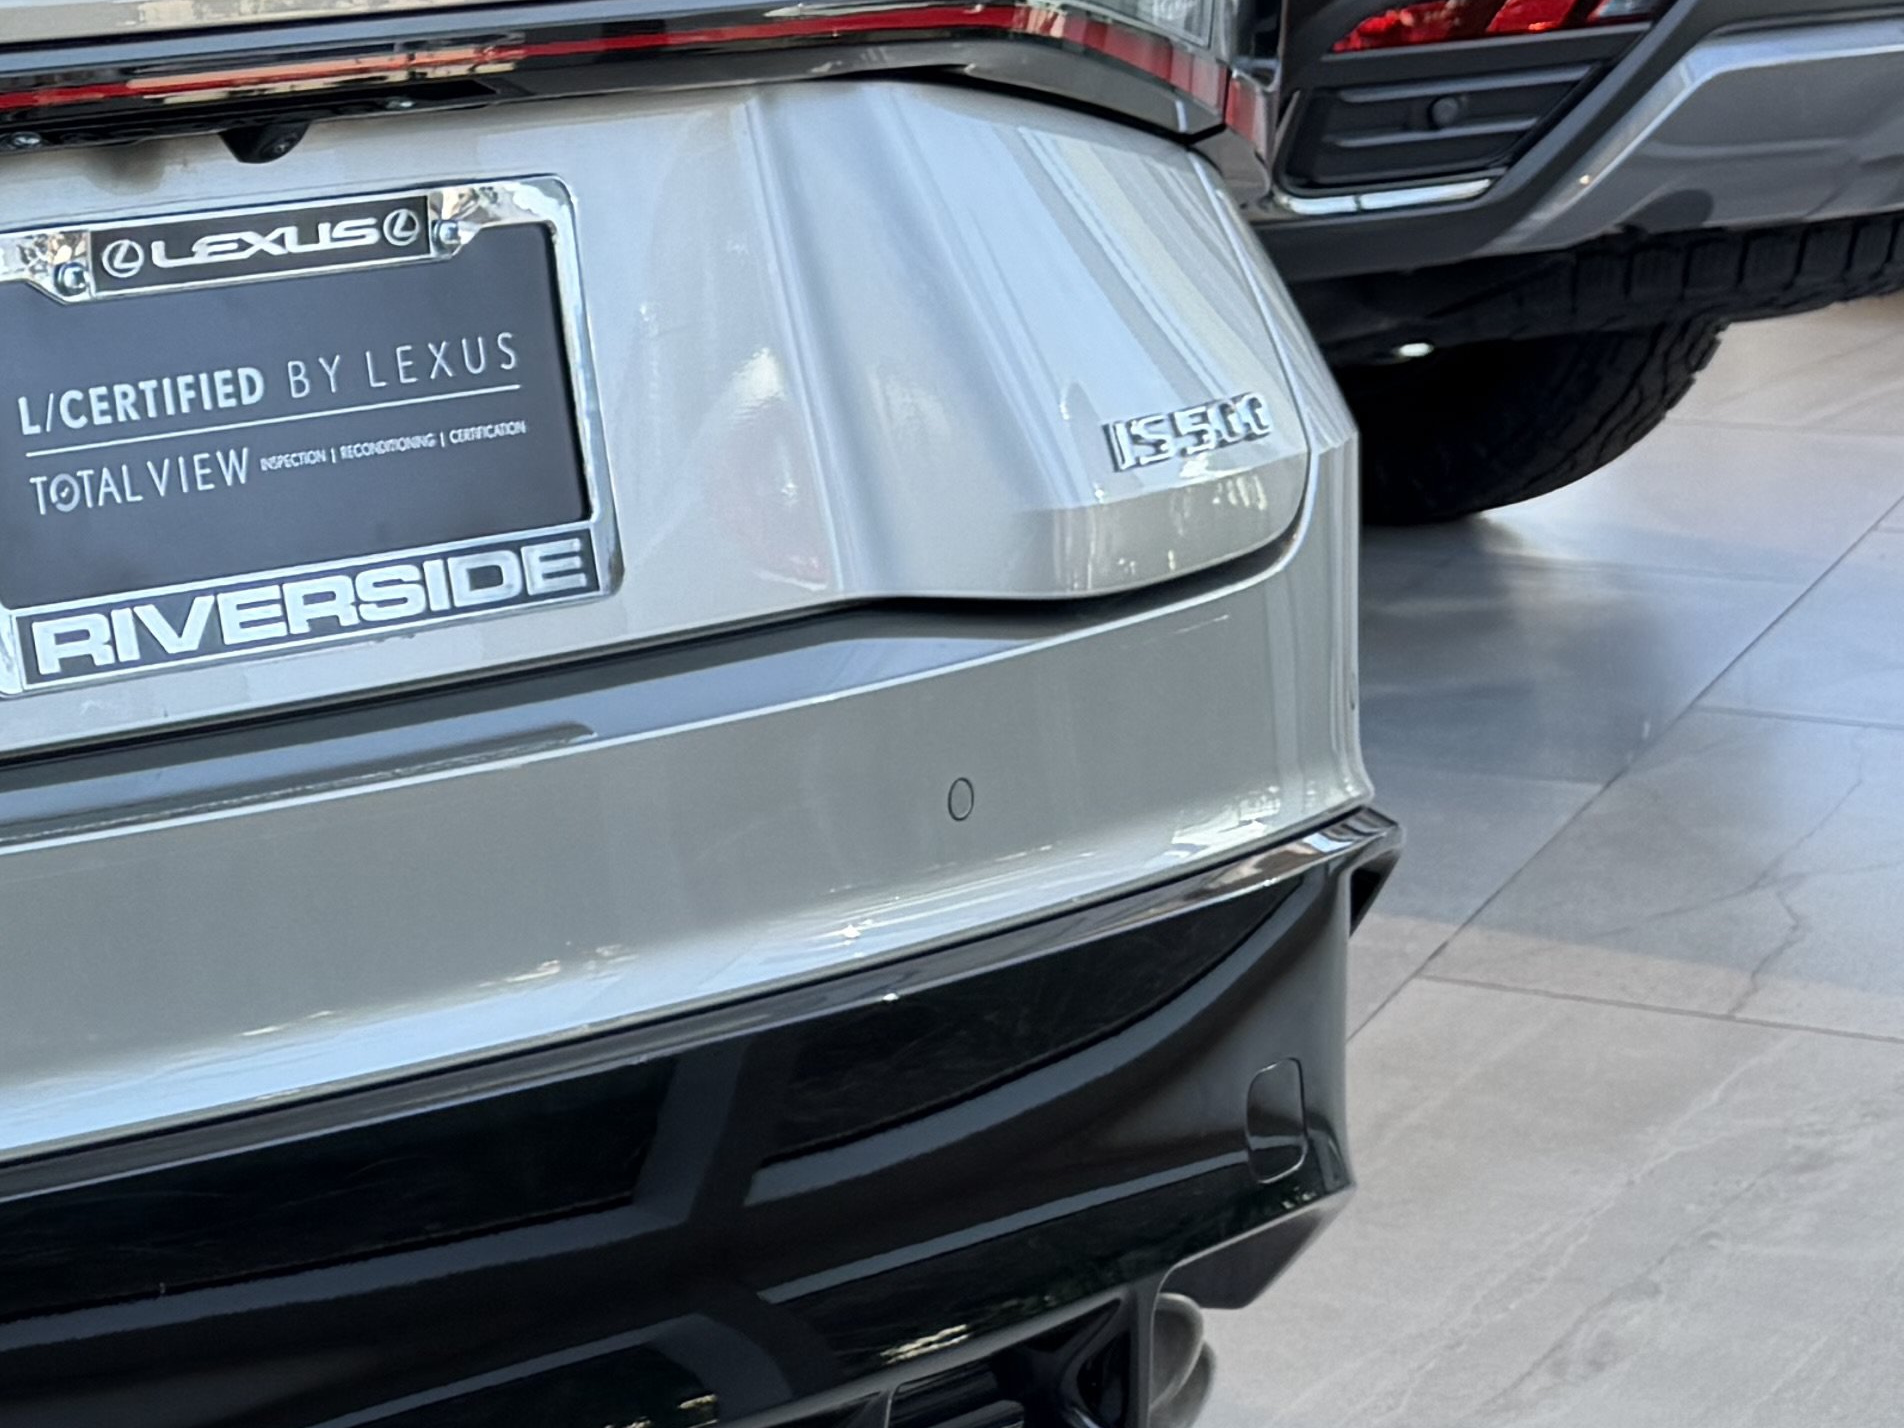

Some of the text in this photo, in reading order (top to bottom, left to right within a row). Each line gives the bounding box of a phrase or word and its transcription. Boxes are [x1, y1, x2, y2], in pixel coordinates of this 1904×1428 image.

[151, 217, 379, 269] LEXUS
[17, 331, 518, 435] L/CERTIFIED BY LEXUS
[260, 448, 326, 472] INSPECTION
[339, 433, 437, 460] RECONDITIONING
[449, 419, 527, 444] CERTIFICATION
[31, 539, 587, 675] RIVERSIDE
